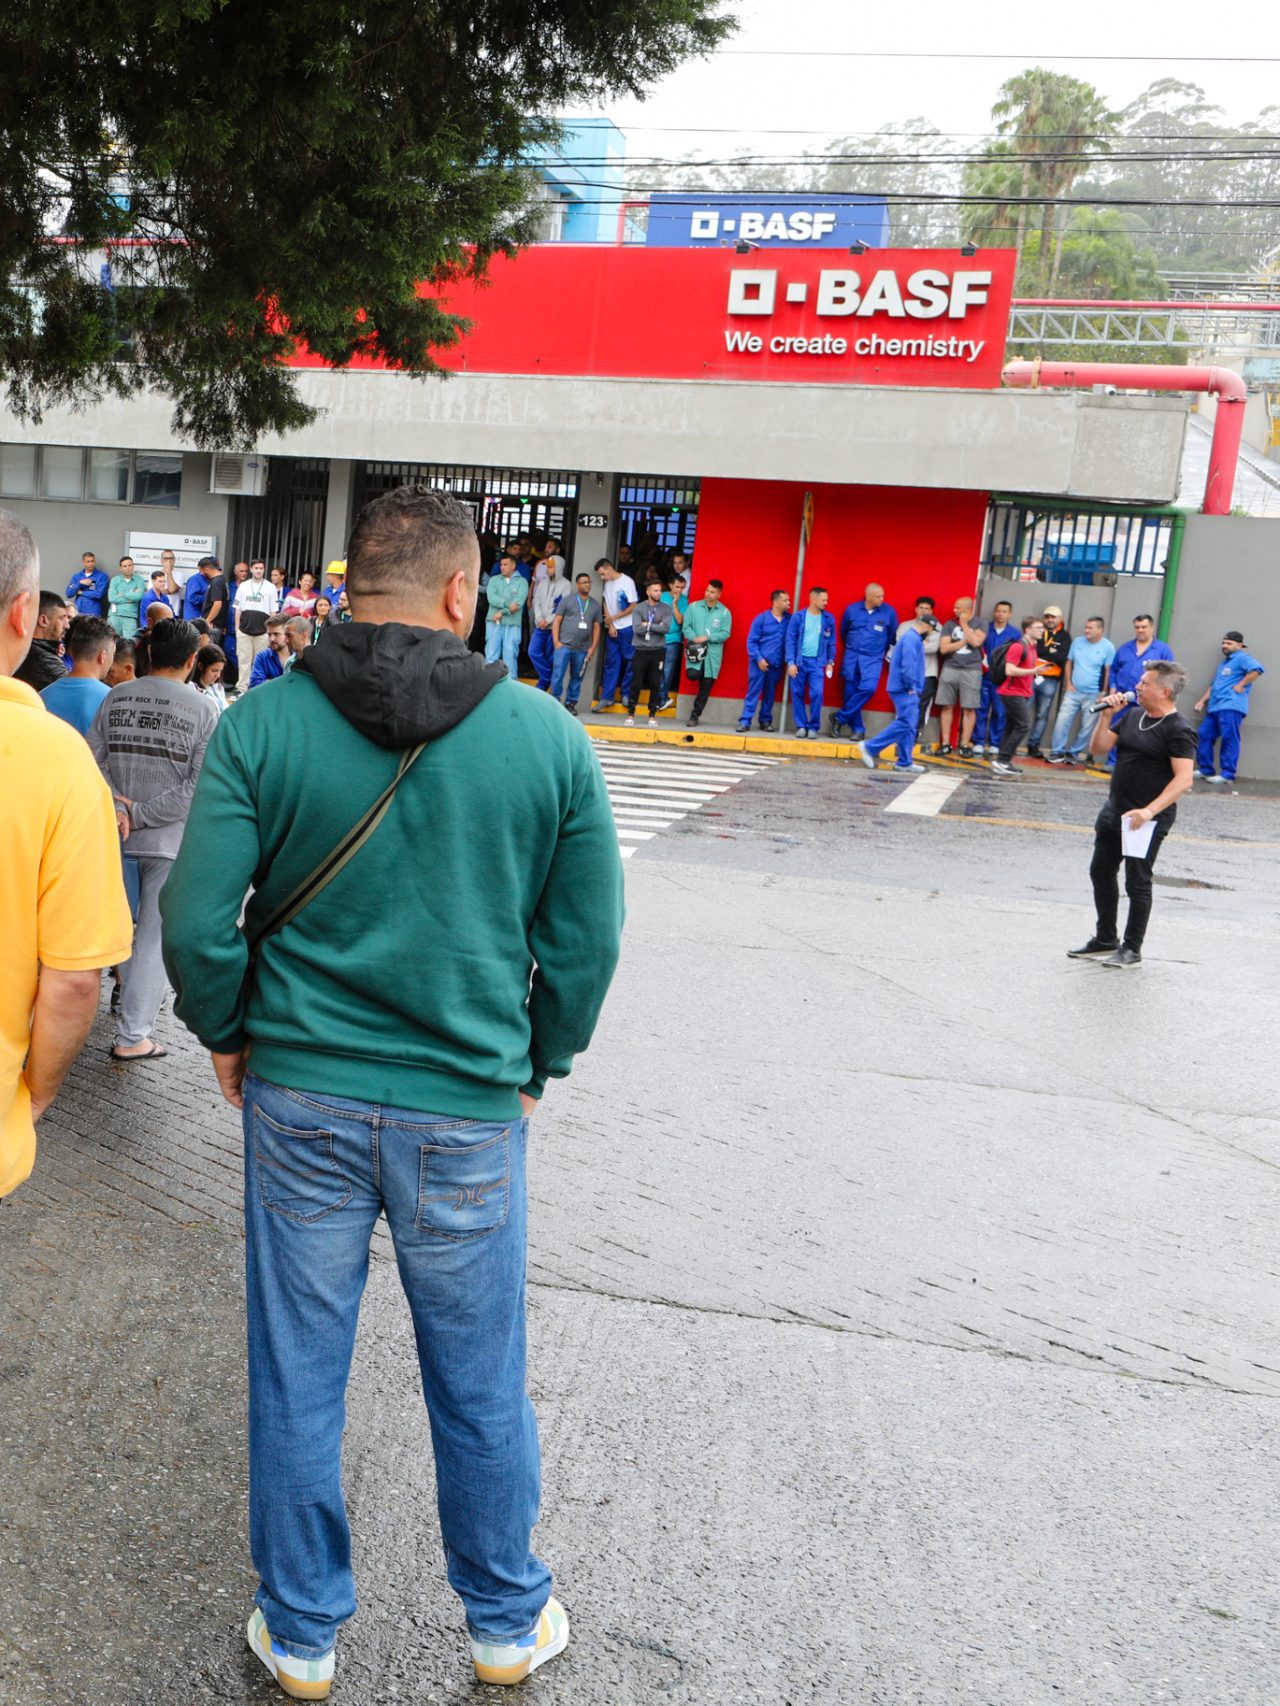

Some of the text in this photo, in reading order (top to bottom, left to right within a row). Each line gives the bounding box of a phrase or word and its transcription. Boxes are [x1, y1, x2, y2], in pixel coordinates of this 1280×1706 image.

[739, 212, 836, 241] BASF
[817, 269, 992, 318] BASF
[724, 331, 985, 362] We create chemistry
[582, 515, 604, 527] 123
[135, 696, 151, 704] ROCK
[154, 698, 170, 706] TOUR
[108, 718, 133, 728] SOUL
